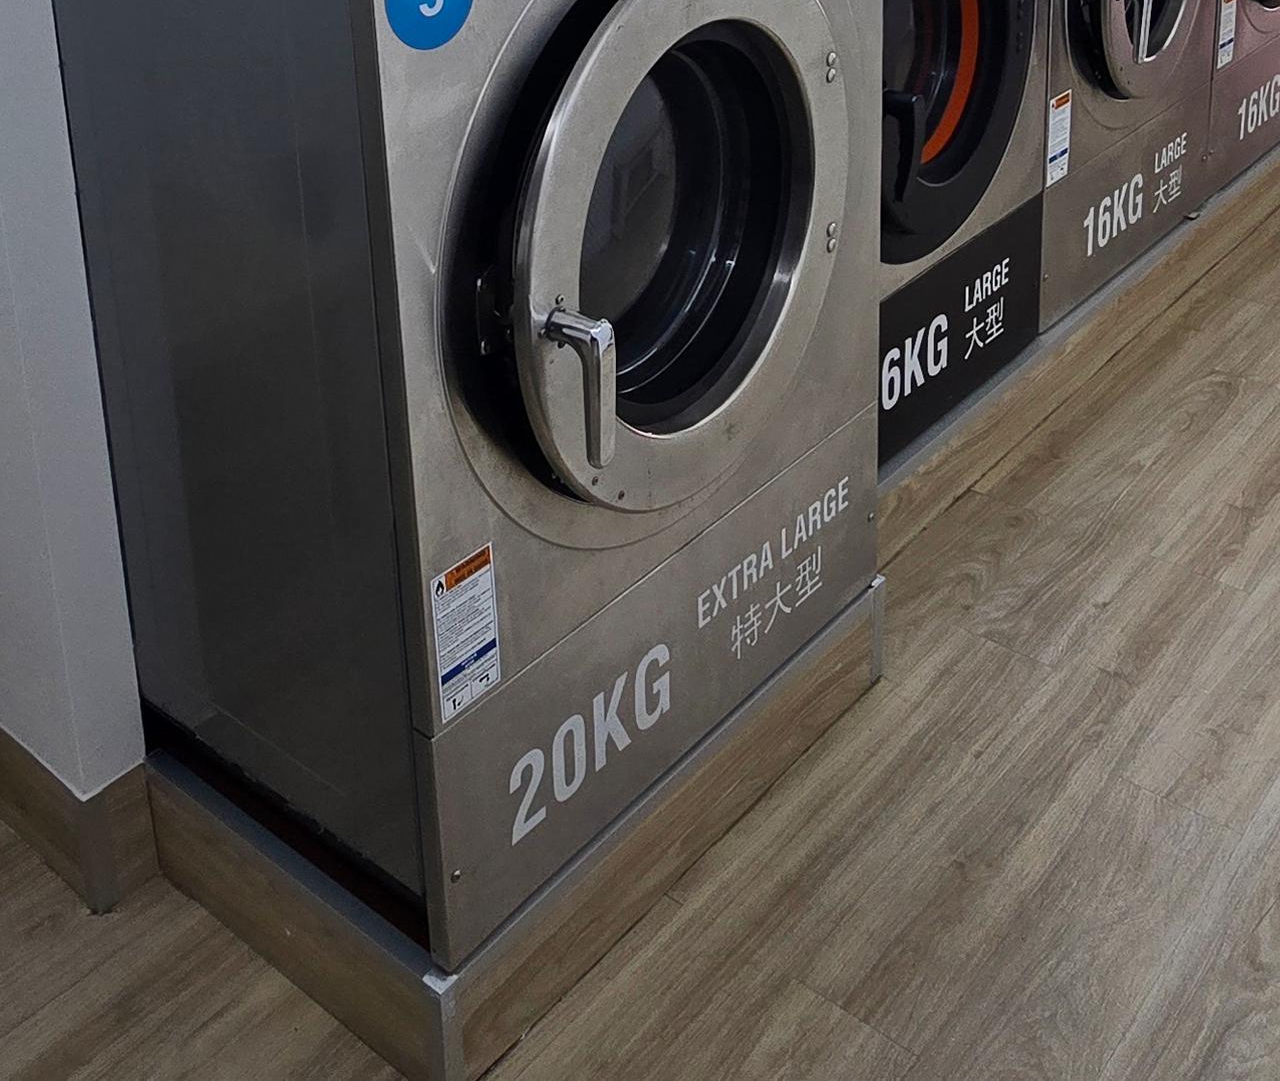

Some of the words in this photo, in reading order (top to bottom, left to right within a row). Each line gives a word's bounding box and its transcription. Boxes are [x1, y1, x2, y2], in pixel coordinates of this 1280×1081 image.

[1238, 74, 1280, 140] 16KG
[1154, 132, 1187, 174] LARGE
[1083, 174, 1143, 256] 16KG
[1153, 169, 1182, 213] 大型
[965, 257, 1010, 312] LARGE
[882, 314, 948, 410] 6KG
[965, 296, 1004, 360] 大型
[698, 542, 773, 629] EXTRA
[780, 476, 849, 559] LARGE
[731, 546, 823, 660] 特大型
[509, 644, 671, 846] 20KG
